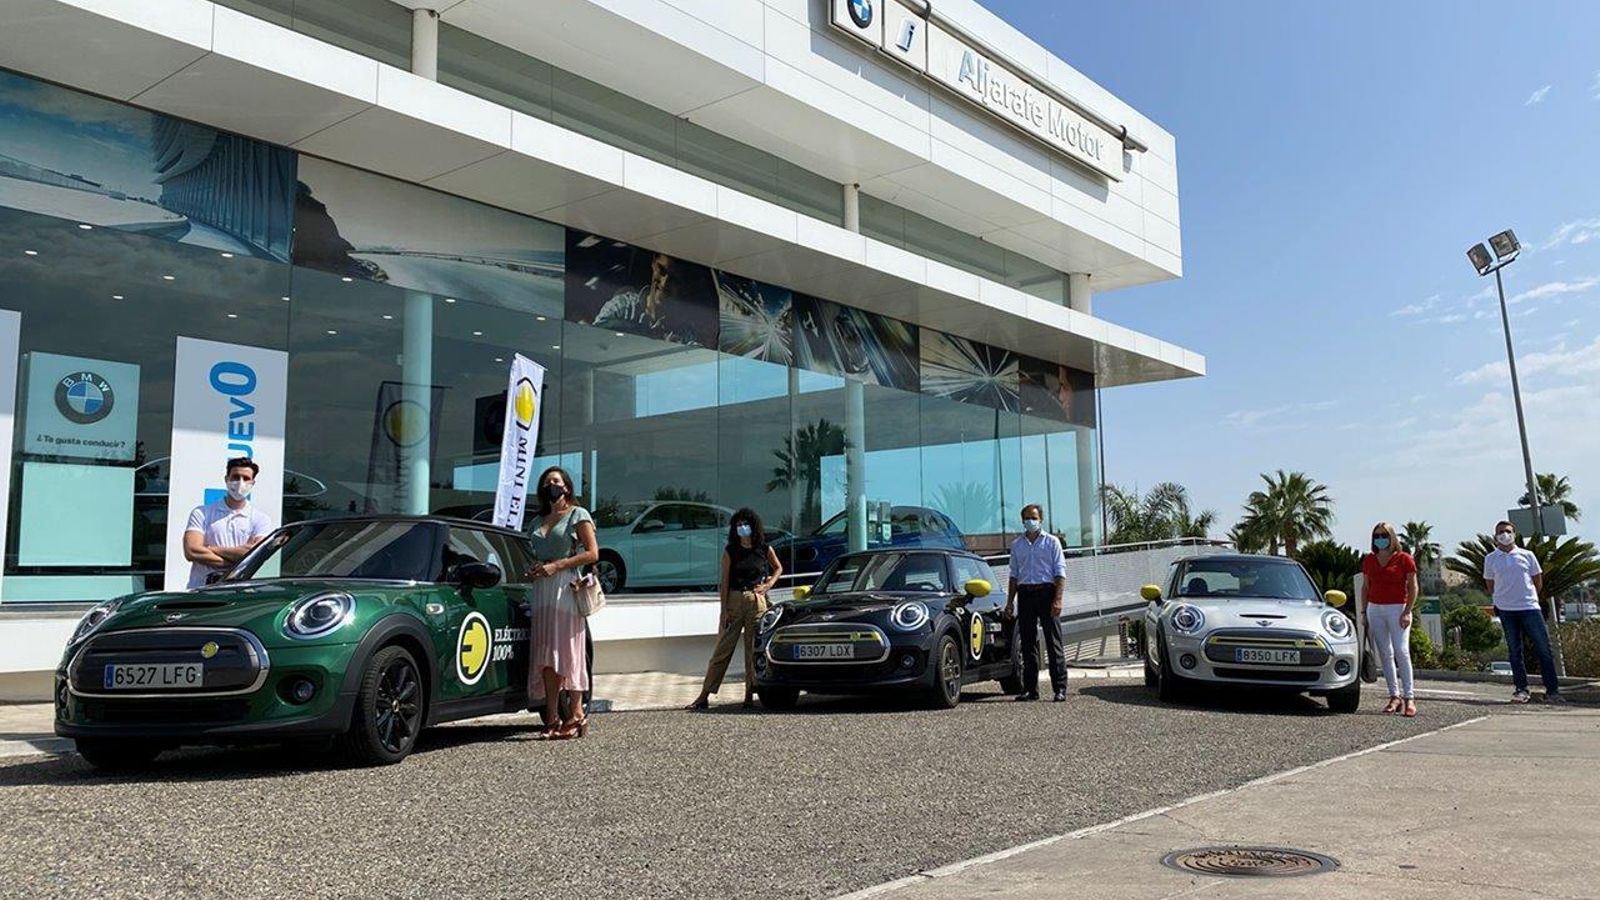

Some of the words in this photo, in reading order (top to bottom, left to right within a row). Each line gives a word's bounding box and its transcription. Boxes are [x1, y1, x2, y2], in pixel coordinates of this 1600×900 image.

[958, 50, 1044, 128] Aljarafe
[1047, 101, 1104, 161] Motor
[62, 373, 110, 392] BMW
[55, 437, 81, 446] gusta
[205, 361, 257, 506] UEVO
[514, 437, 528, 487] MINI
[492, 644, 514, 661] 100%
[800, 645, 826, 657] 6307
[829, 645, 851, 657] LDX
[1243, 650, 1272, 662] 8350
[1275, 651, 1297, 663] LFK
[115, 666, 157, 685] 6527
[162, 666, 197, 684] LFG
